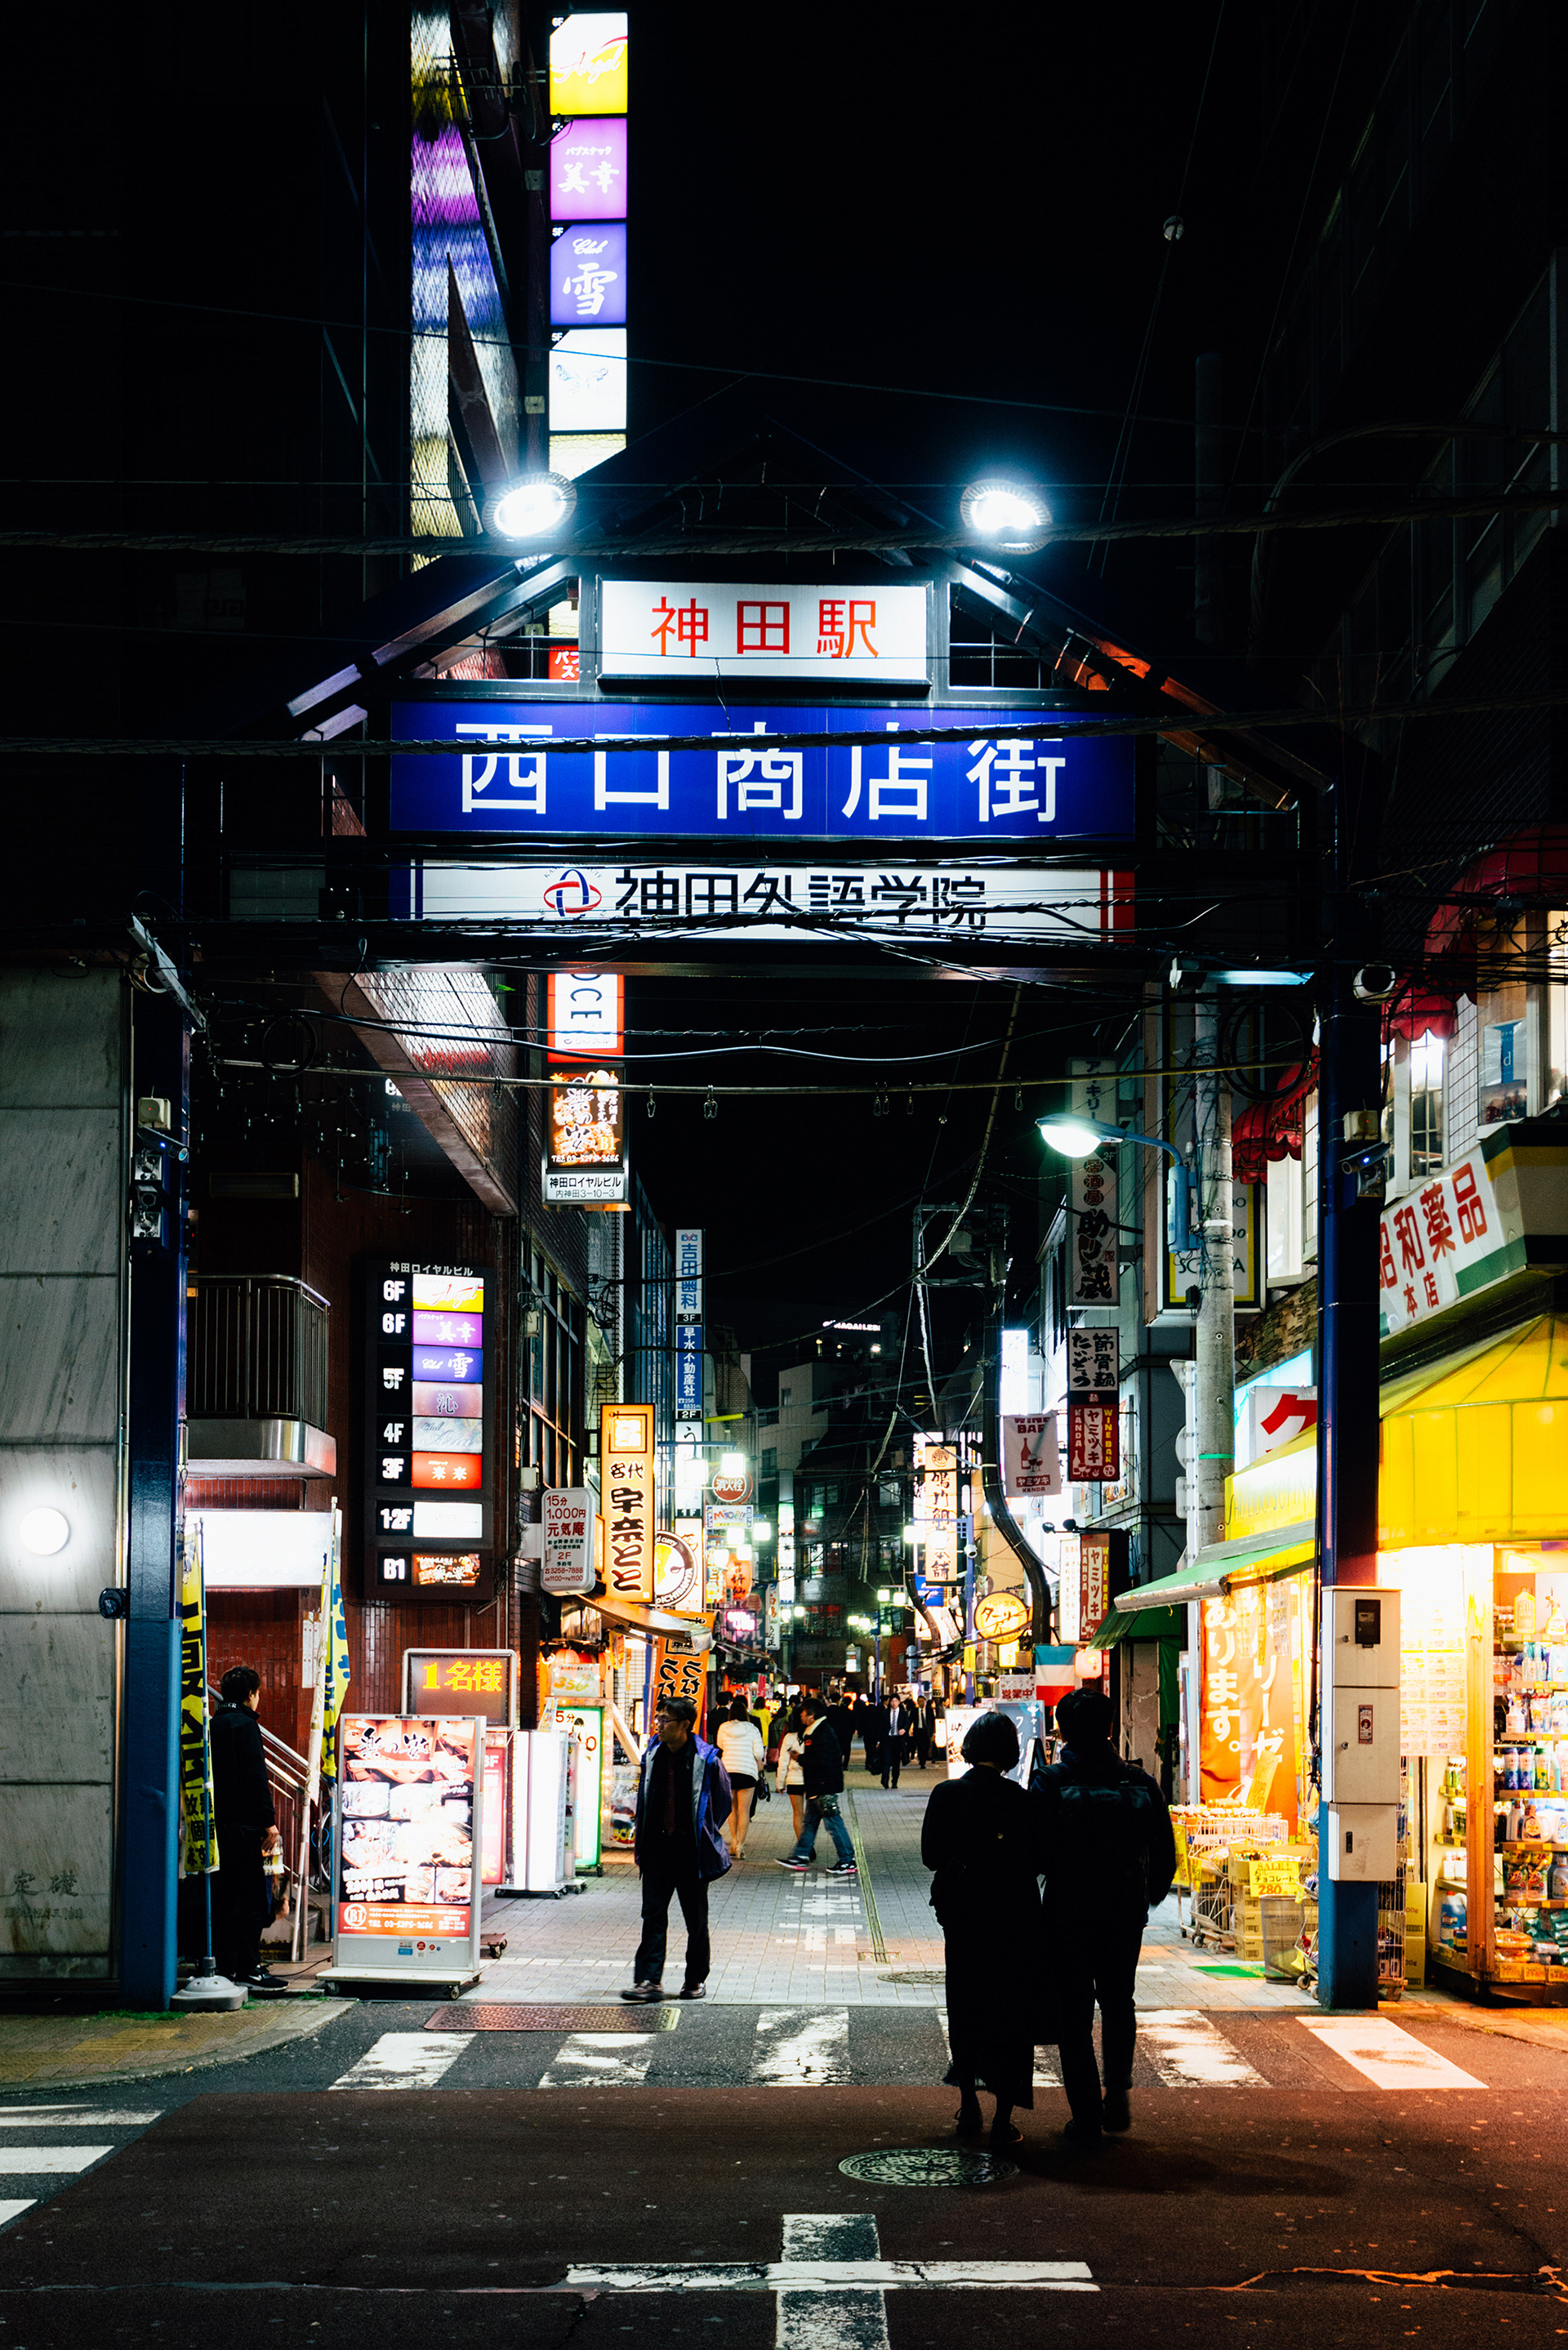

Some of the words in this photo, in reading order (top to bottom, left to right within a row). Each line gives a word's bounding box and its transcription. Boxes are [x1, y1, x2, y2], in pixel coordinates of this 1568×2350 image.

[557, 161, 620, 194] 美幸
[563, 262, 617, 315] 雪
[651, 596, 879, 658] 神田駅
[455, 722, 1067, 823] 西口商店街
[615, 868, 986, 930] 神田外語学院
[550, 1177, 621, 1188] 神田ロイヤルビル
[390, 1261, 474, 1276] 神田ロイヤルビル
[680, 1243, 697, 1309] 吉田歯科
[383, 1279, 405, 1301] 6F
[1403, 1271, 1440, 1318] 本店
[382, 1313, 406, 1333] 6F
[683, 1313, 696, 1322] 3F
[435, 1320, 475, 1344] 美幸
[448, 1352, 474, 1378] 雪
[383, 1367, 404, 1389] 5F
[383, 1423, 404, 1443] 4F
[1075, 1408, 1083, 1447] KANDA
[1087, 1409, 1101, 1465] ヤミツキ
[382, 1458, 404, 1479] 3F
[610, 1461, 644, 1479] 名代
[715, 1478, 743, 1492] 消火栓
[1018, 1477, 1049, 1487] ヤミツキ
[546, 1495, 568, 1507] 15分
[546, 1508, 586, 1519] 1,000円
[547, 1522, 586, 1537] 元気庵
[610, 1487, 645, 1592] 宇奈とと
[558, 1551, 572, 1559] 2F
[384, 1558, 405, 1580] B1
[1090, 1549, 1101, 1617] ヤミツキ
[422, 1661, 502, 1692] 1名様
[1205, 1597, 1241, 1753] あります。
[1258, 1884, 1282, 1895] 280
